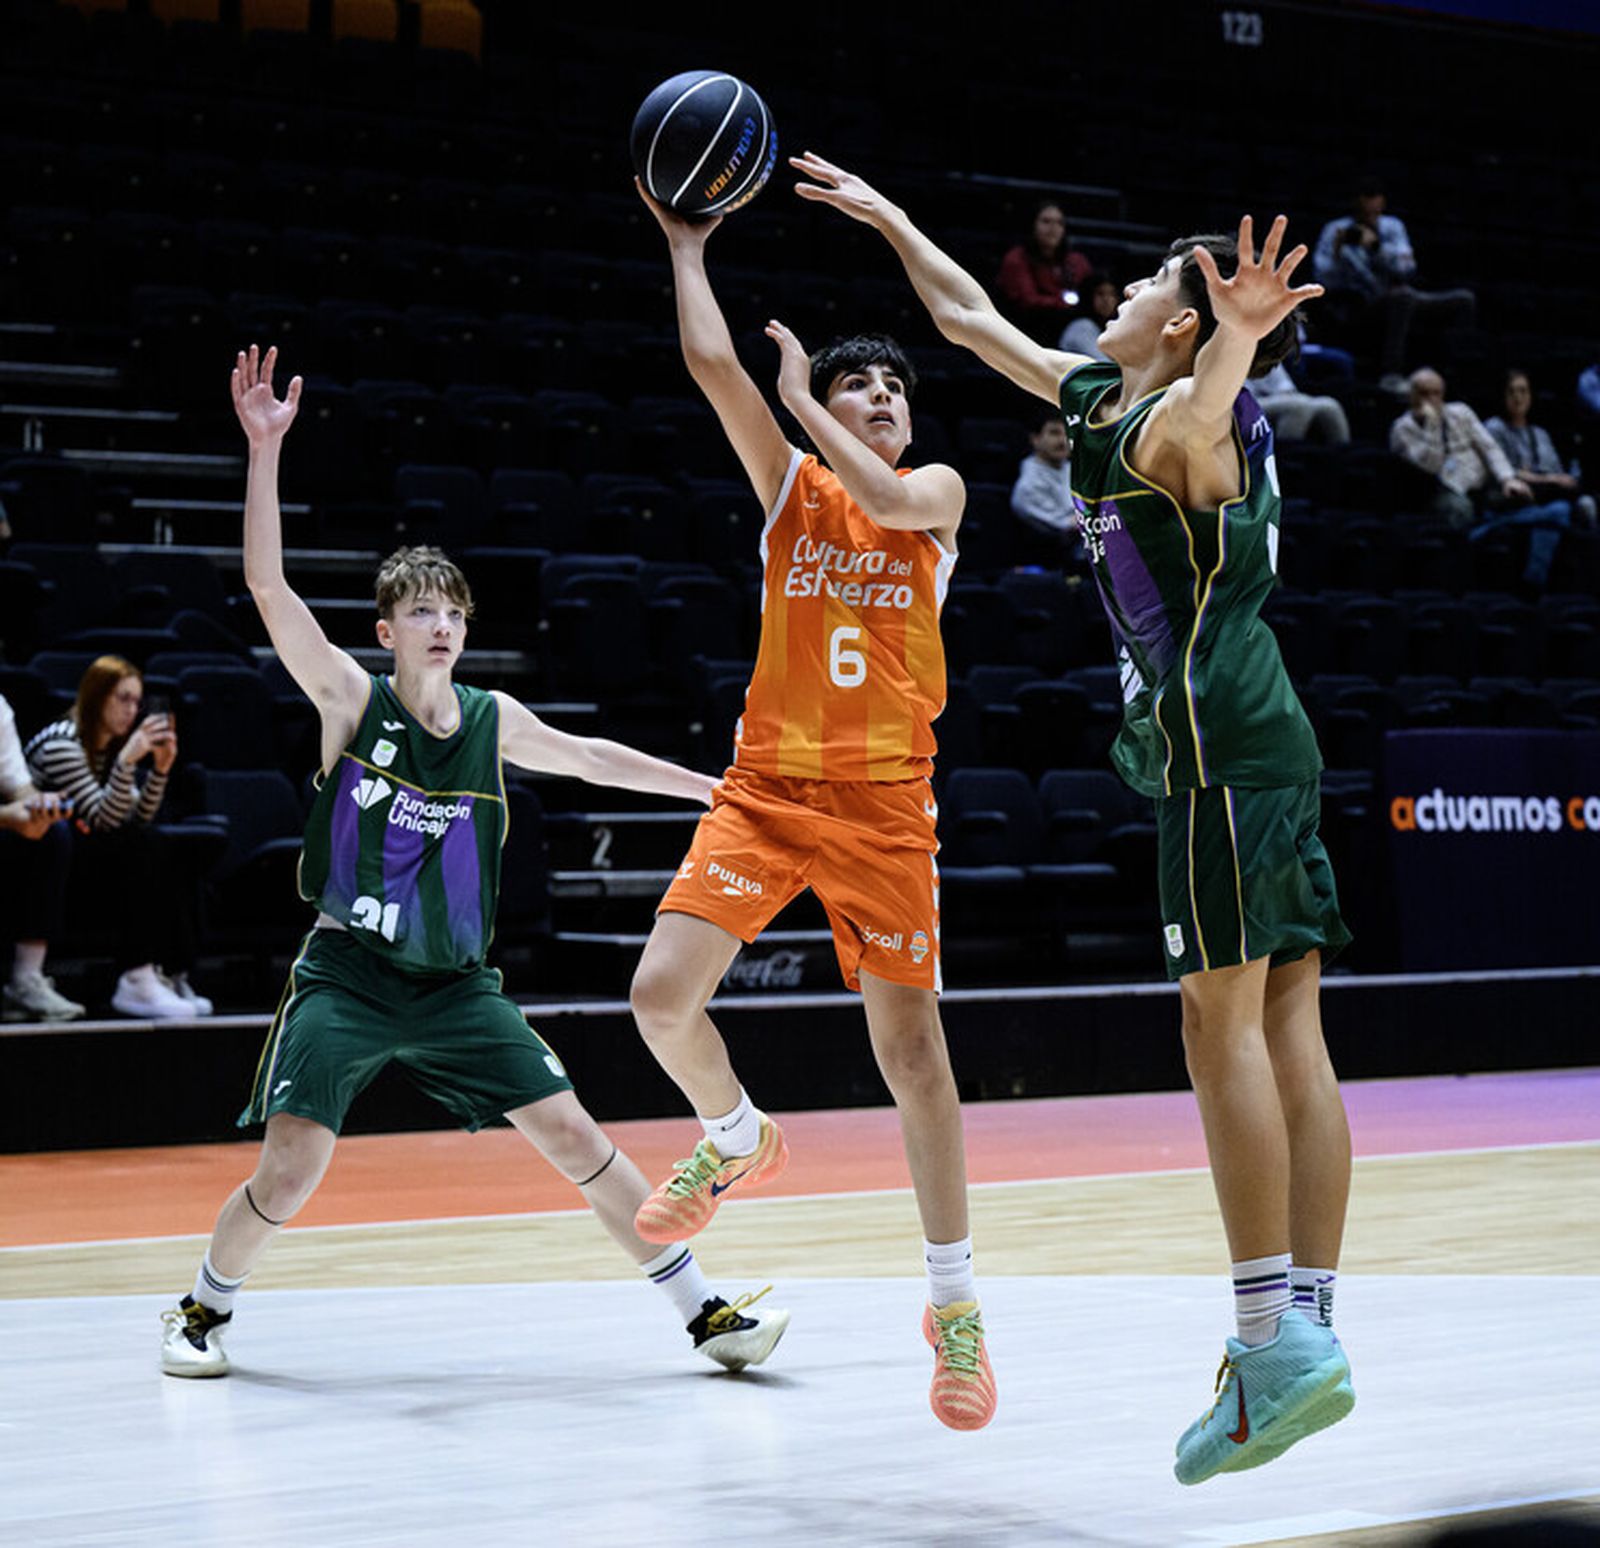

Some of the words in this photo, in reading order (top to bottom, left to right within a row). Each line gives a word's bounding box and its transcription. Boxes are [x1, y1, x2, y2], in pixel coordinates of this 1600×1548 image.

[1221, 11, 1264, 46] 123
[792, 534, 886, 574] Cultura
[888, 560, 912, 576] del
[784, 566, 912, 609] Esfuerzo
[829, 626, 866, 688] 6
[1391, 787, 1562, 832] actuamos
[591, 826, 614, 868] 2
[707, 861, 763, 896] PULEVA
